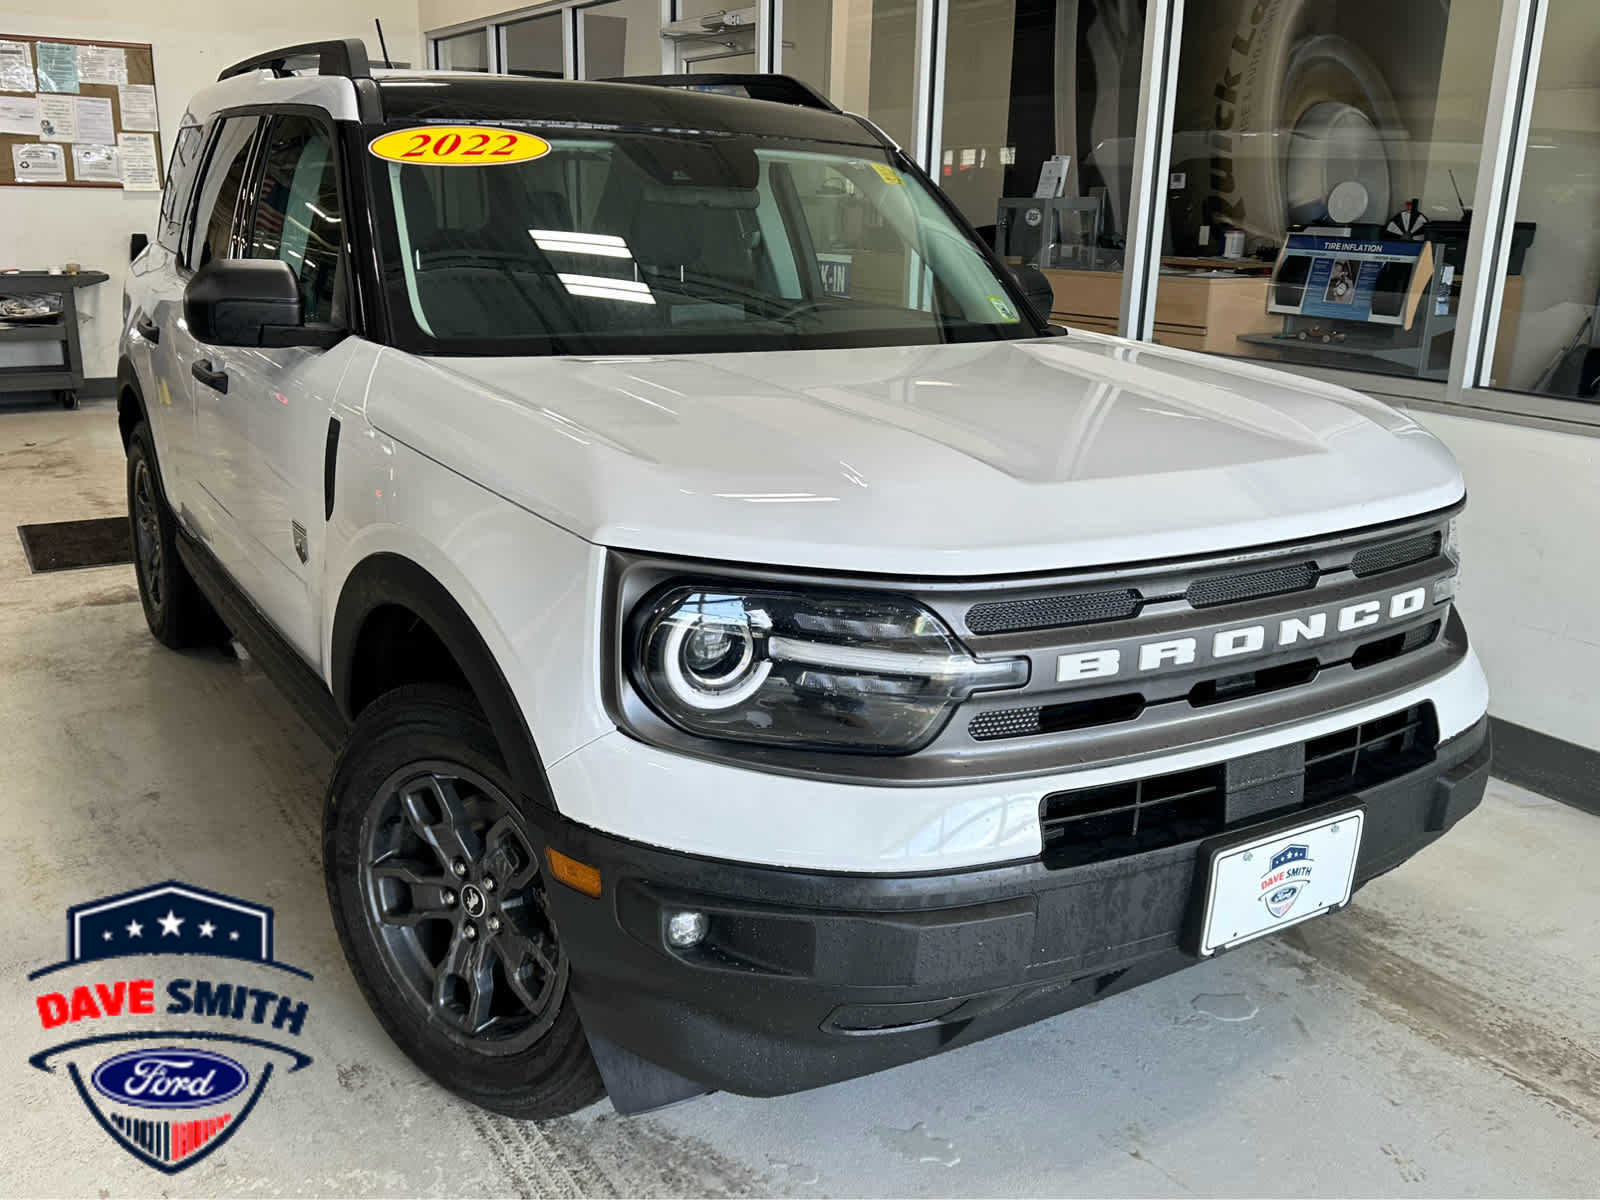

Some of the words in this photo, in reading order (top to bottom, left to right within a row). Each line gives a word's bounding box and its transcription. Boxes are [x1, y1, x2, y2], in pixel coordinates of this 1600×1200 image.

[400, 134, 518, 158] 2022
[1324, 242, 1341, 250] TIRE
[1341, 243, 1383, 252] INFLATION
[1056, 587, 1425, 682] BRONCO
[1261, 871, 1285, 890] DAVE
[1286, 866, 1312, 879] SMITH
